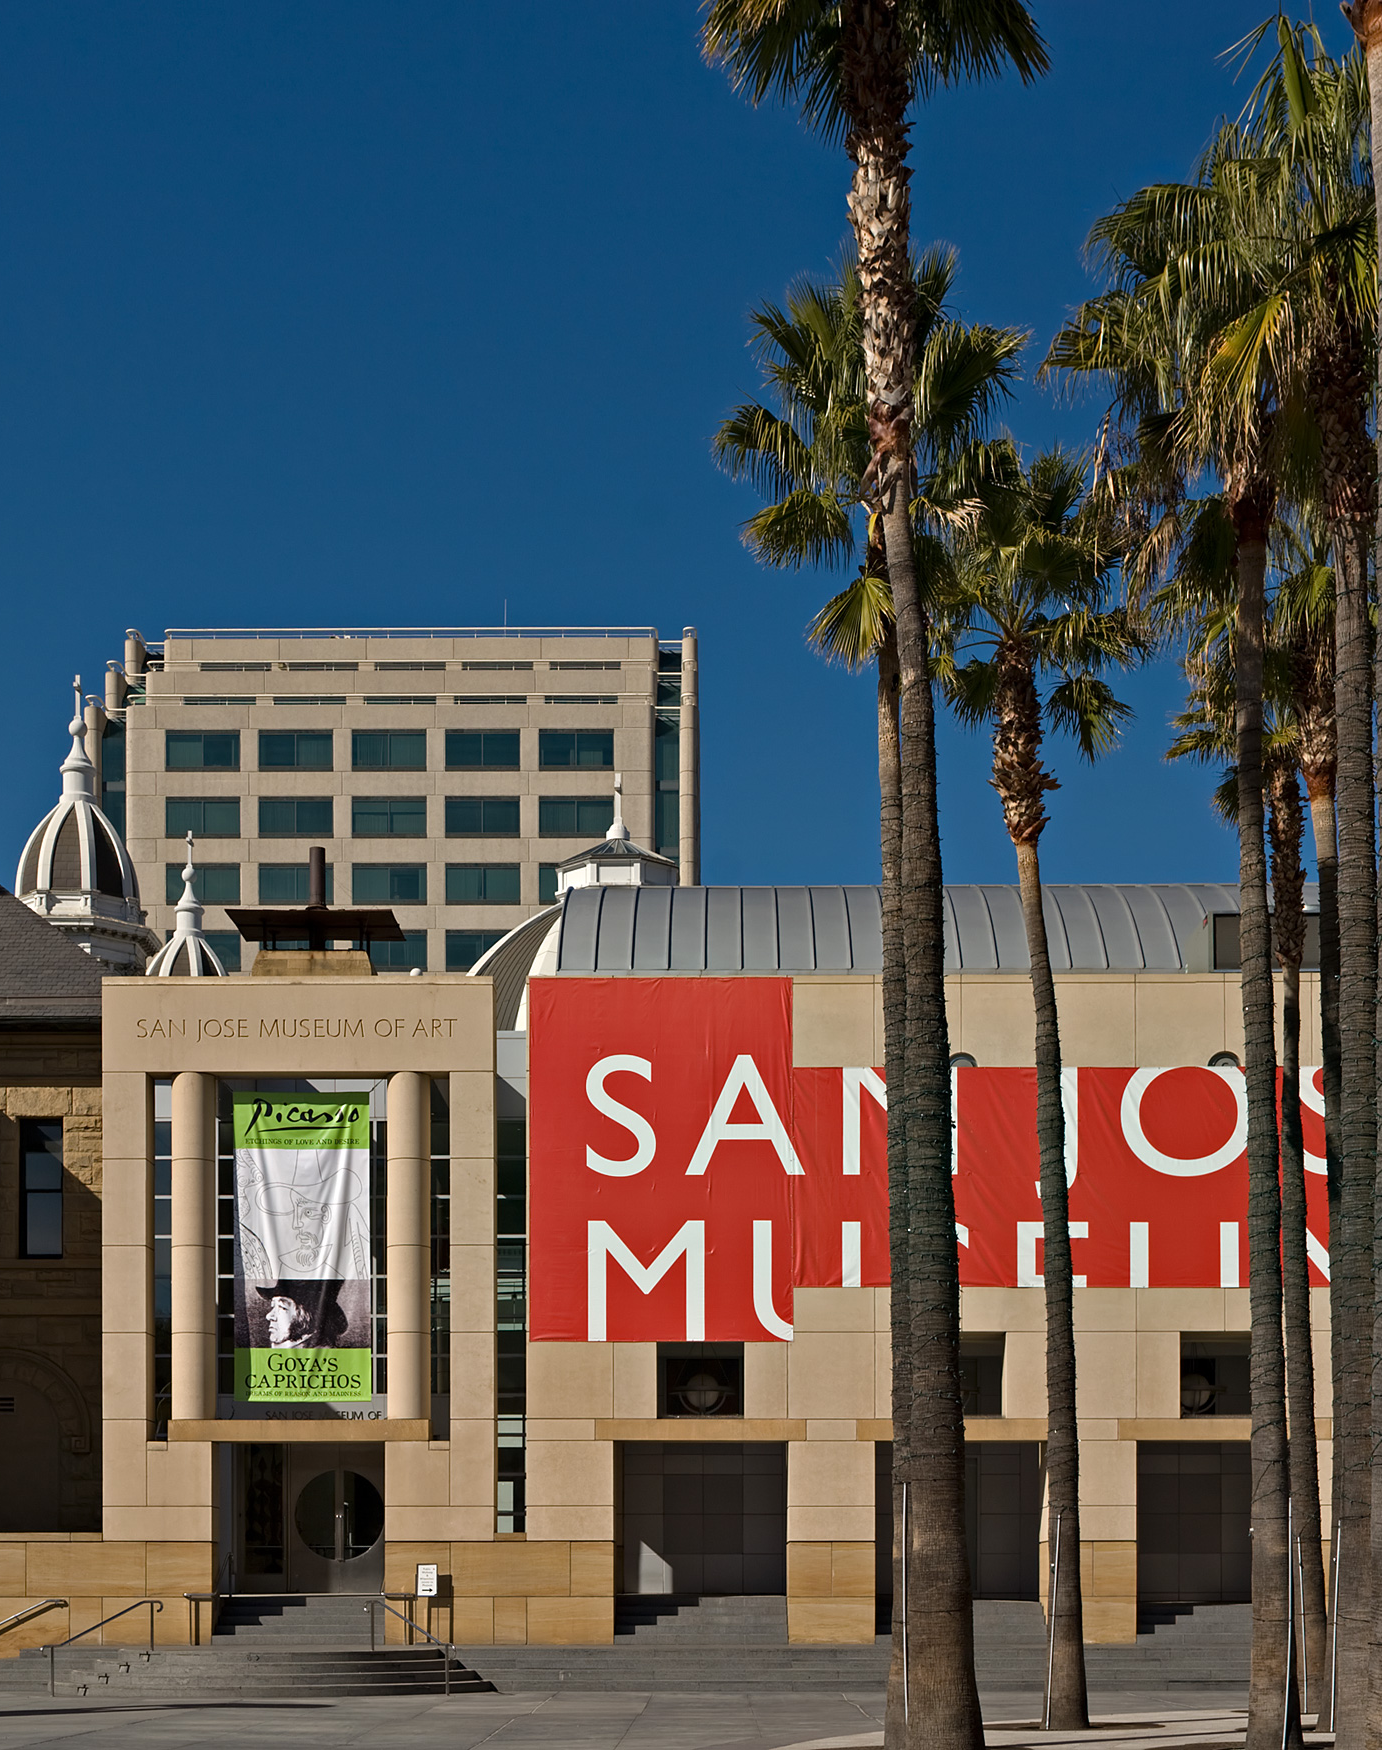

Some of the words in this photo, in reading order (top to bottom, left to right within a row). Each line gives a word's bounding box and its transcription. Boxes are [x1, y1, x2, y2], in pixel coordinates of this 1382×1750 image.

[136, 1018, 187, 1039] SAN
[195, 1018, 249, 1044] JOSE
[259, 1018, 366, 1039] MUSEUM
[373, 1018, 406, 1039] OF
[412, 1018, 459, 1039] ART
[244, 1097, 360, 1137] Picasso
[245, 1374, 362, 1389] CAPRICHOS
[368, 1411, 382, 1420] OF
